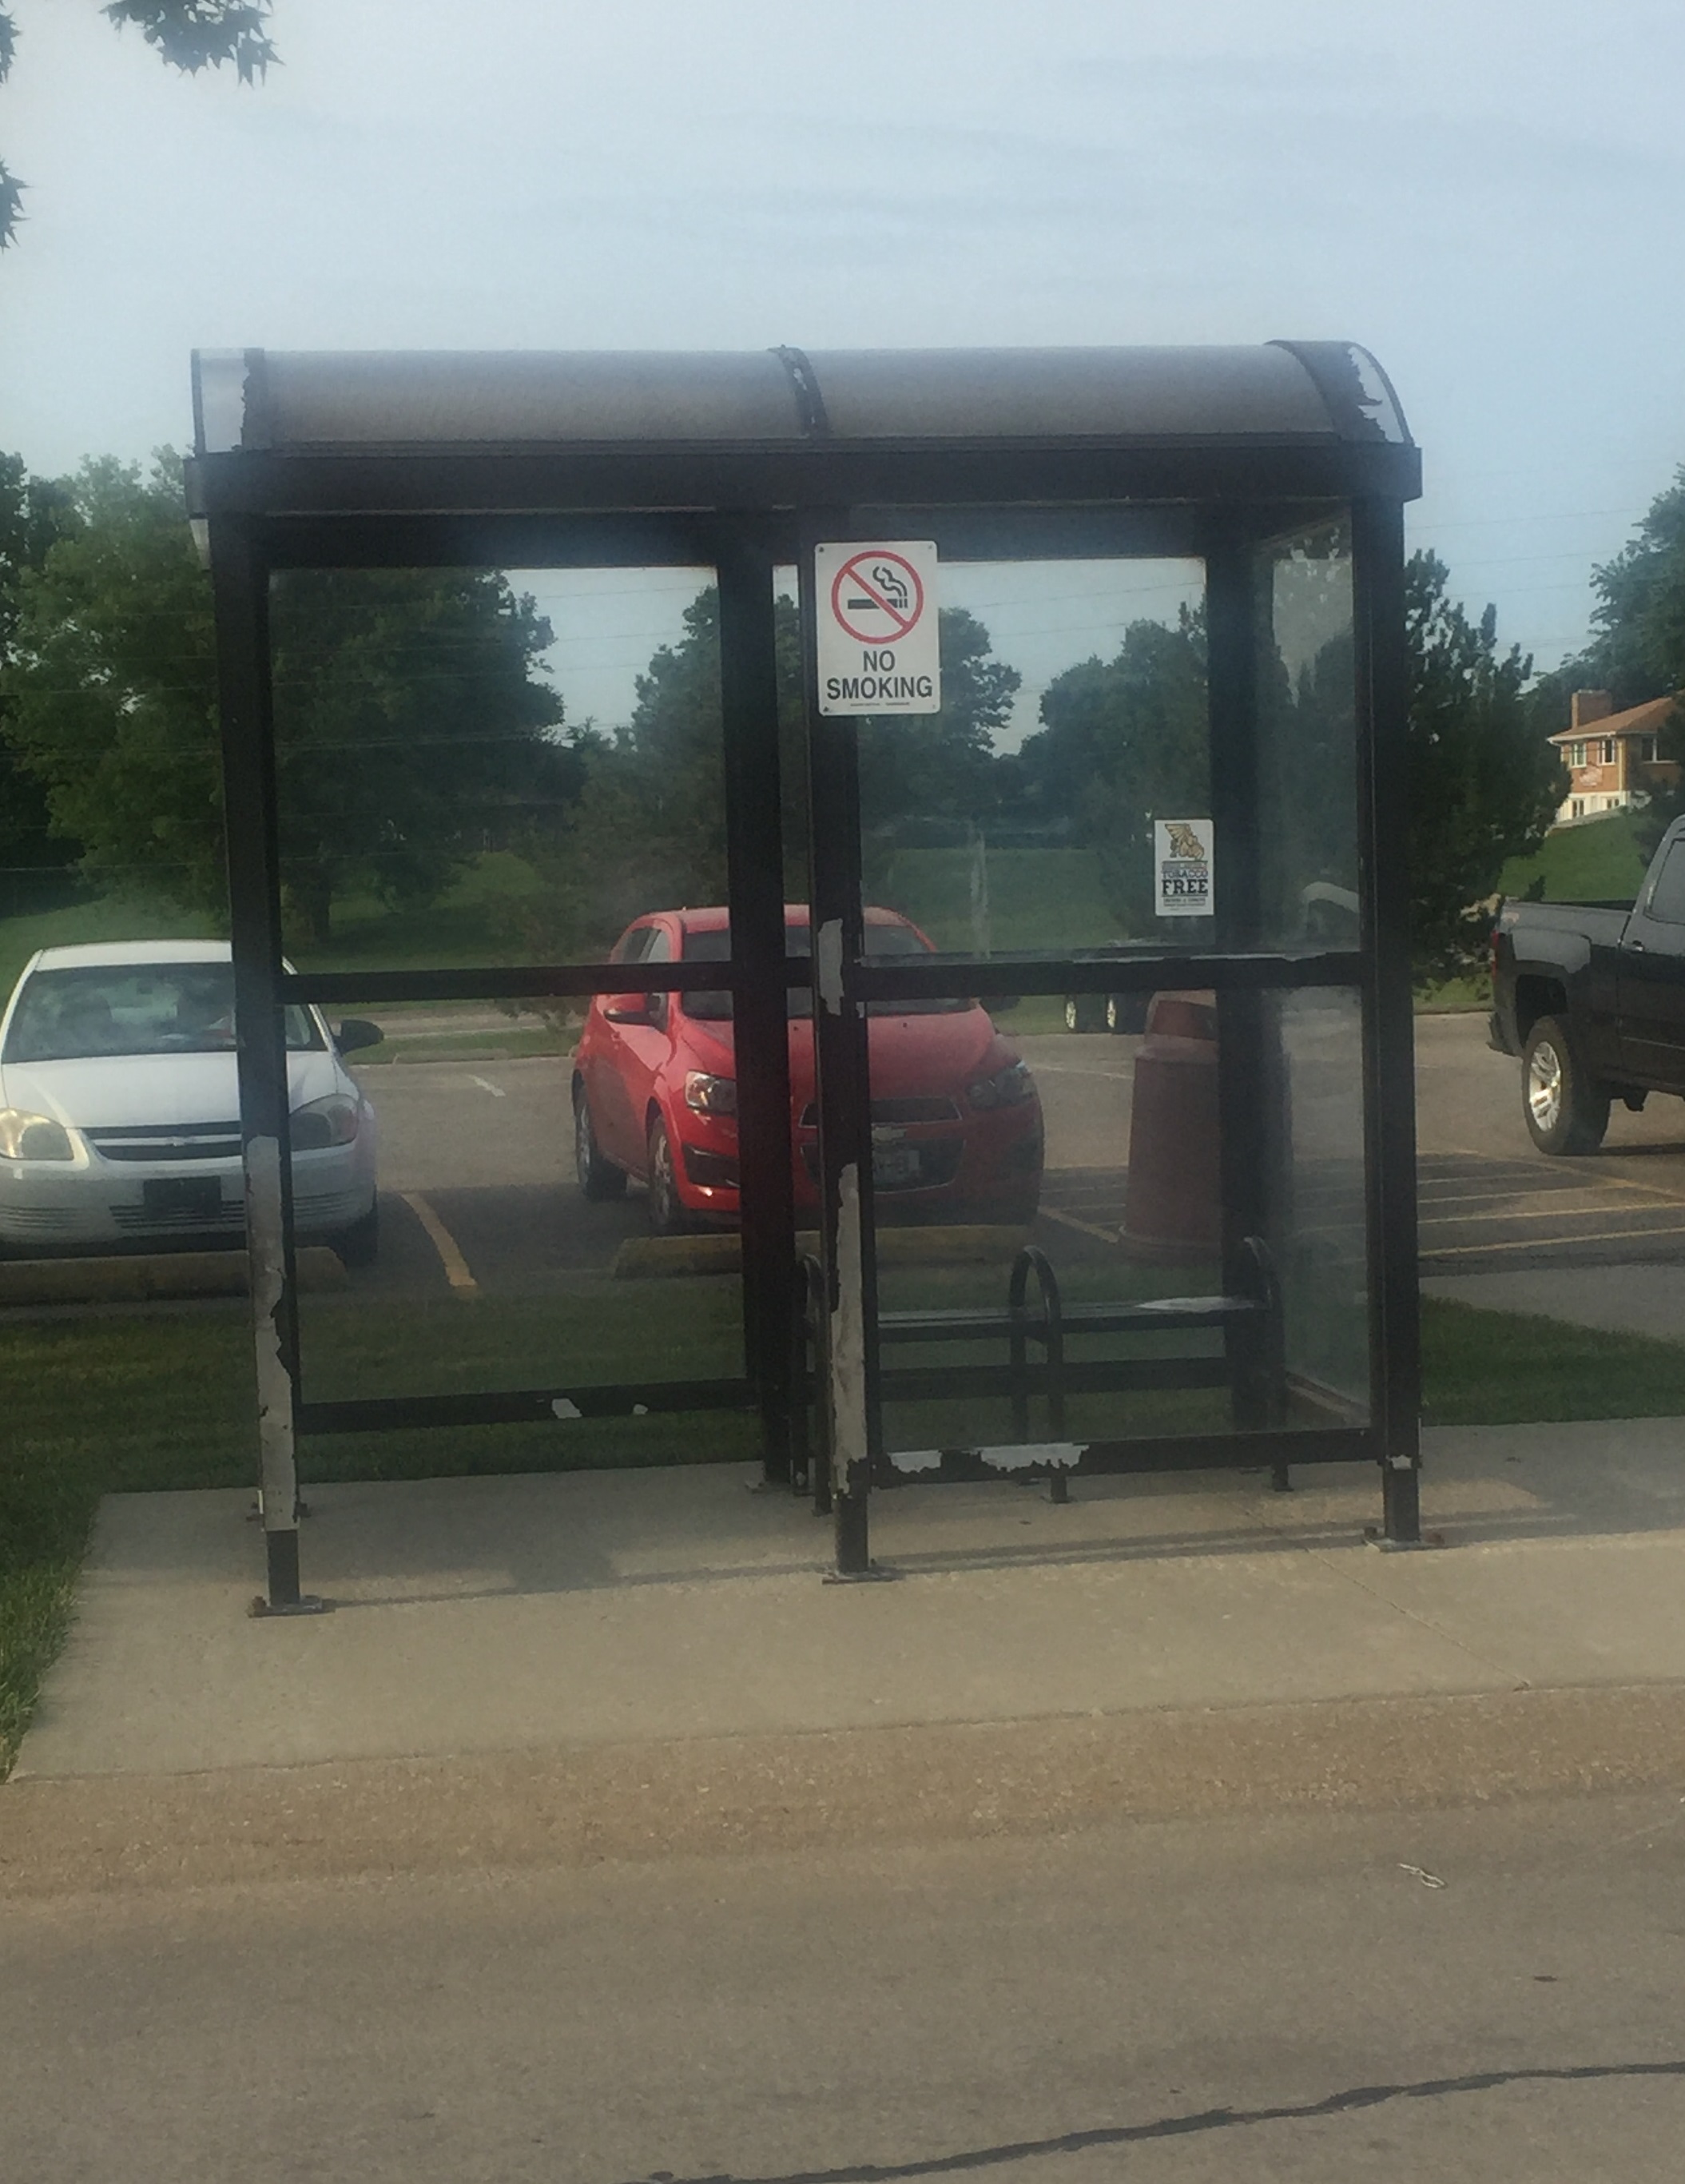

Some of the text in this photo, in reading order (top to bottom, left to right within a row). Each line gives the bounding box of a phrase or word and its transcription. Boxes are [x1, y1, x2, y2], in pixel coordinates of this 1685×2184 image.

[863, 650, 896, 672] NO
[826, 676, 932, 700] SMOKING
[1162, 879, 1209, 894] FREE
